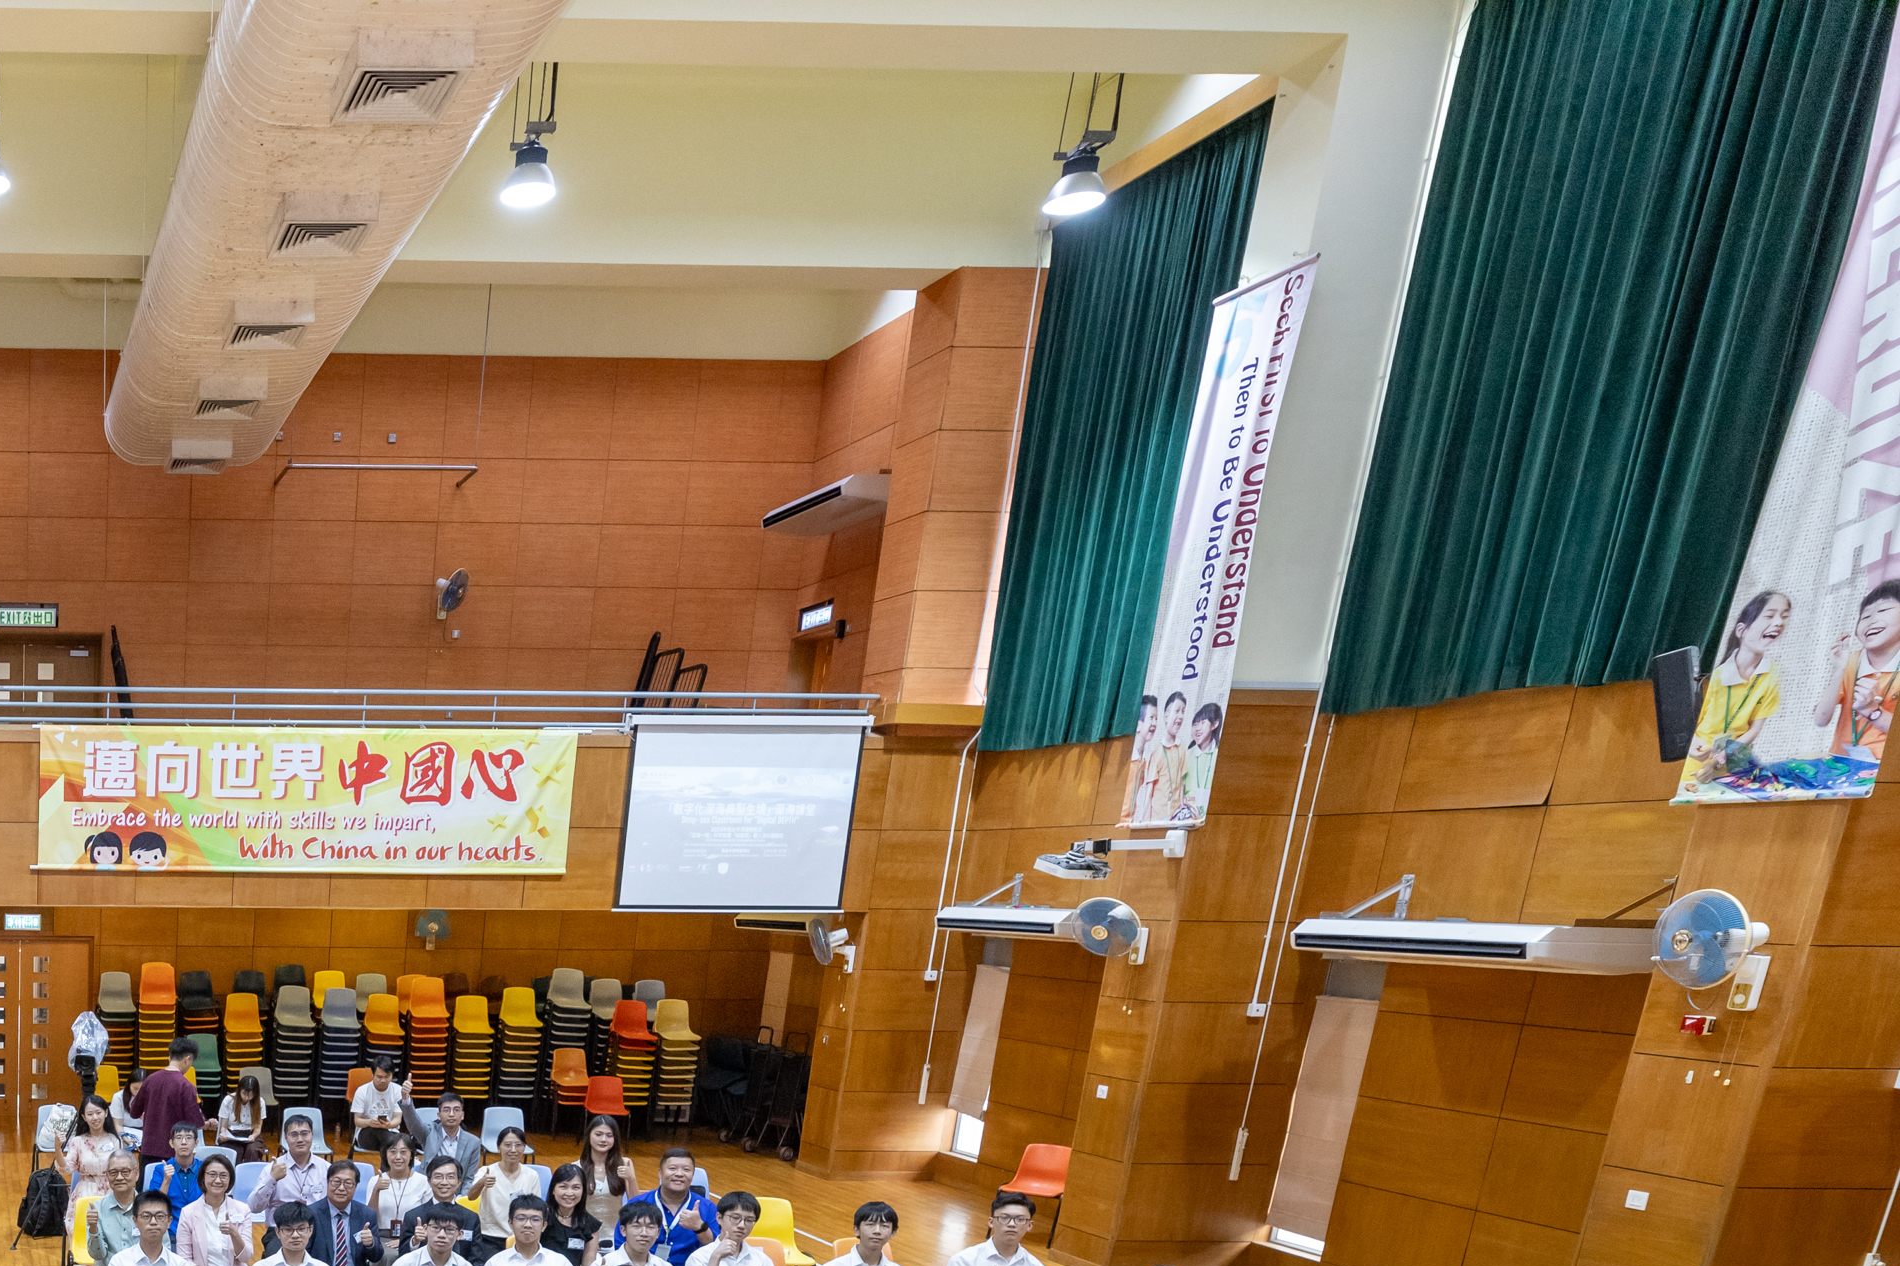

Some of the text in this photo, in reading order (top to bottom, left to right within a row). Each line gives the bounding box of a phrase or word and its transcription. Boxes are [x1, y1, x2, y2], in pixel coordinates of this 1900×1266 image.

[1182, 356, 1259, 681] Then to Be Understood
[1212, 462, 1265, 648] Understand
[0, 611, 21, 625] EXIT
[33, 611, 53, 625] 出口
[70, 807, 437, 835] Embrace the world with skills we impart,
[238, 834, 544, 864] With China in our hearts.
[6, 916, 24, 929] EXIT
